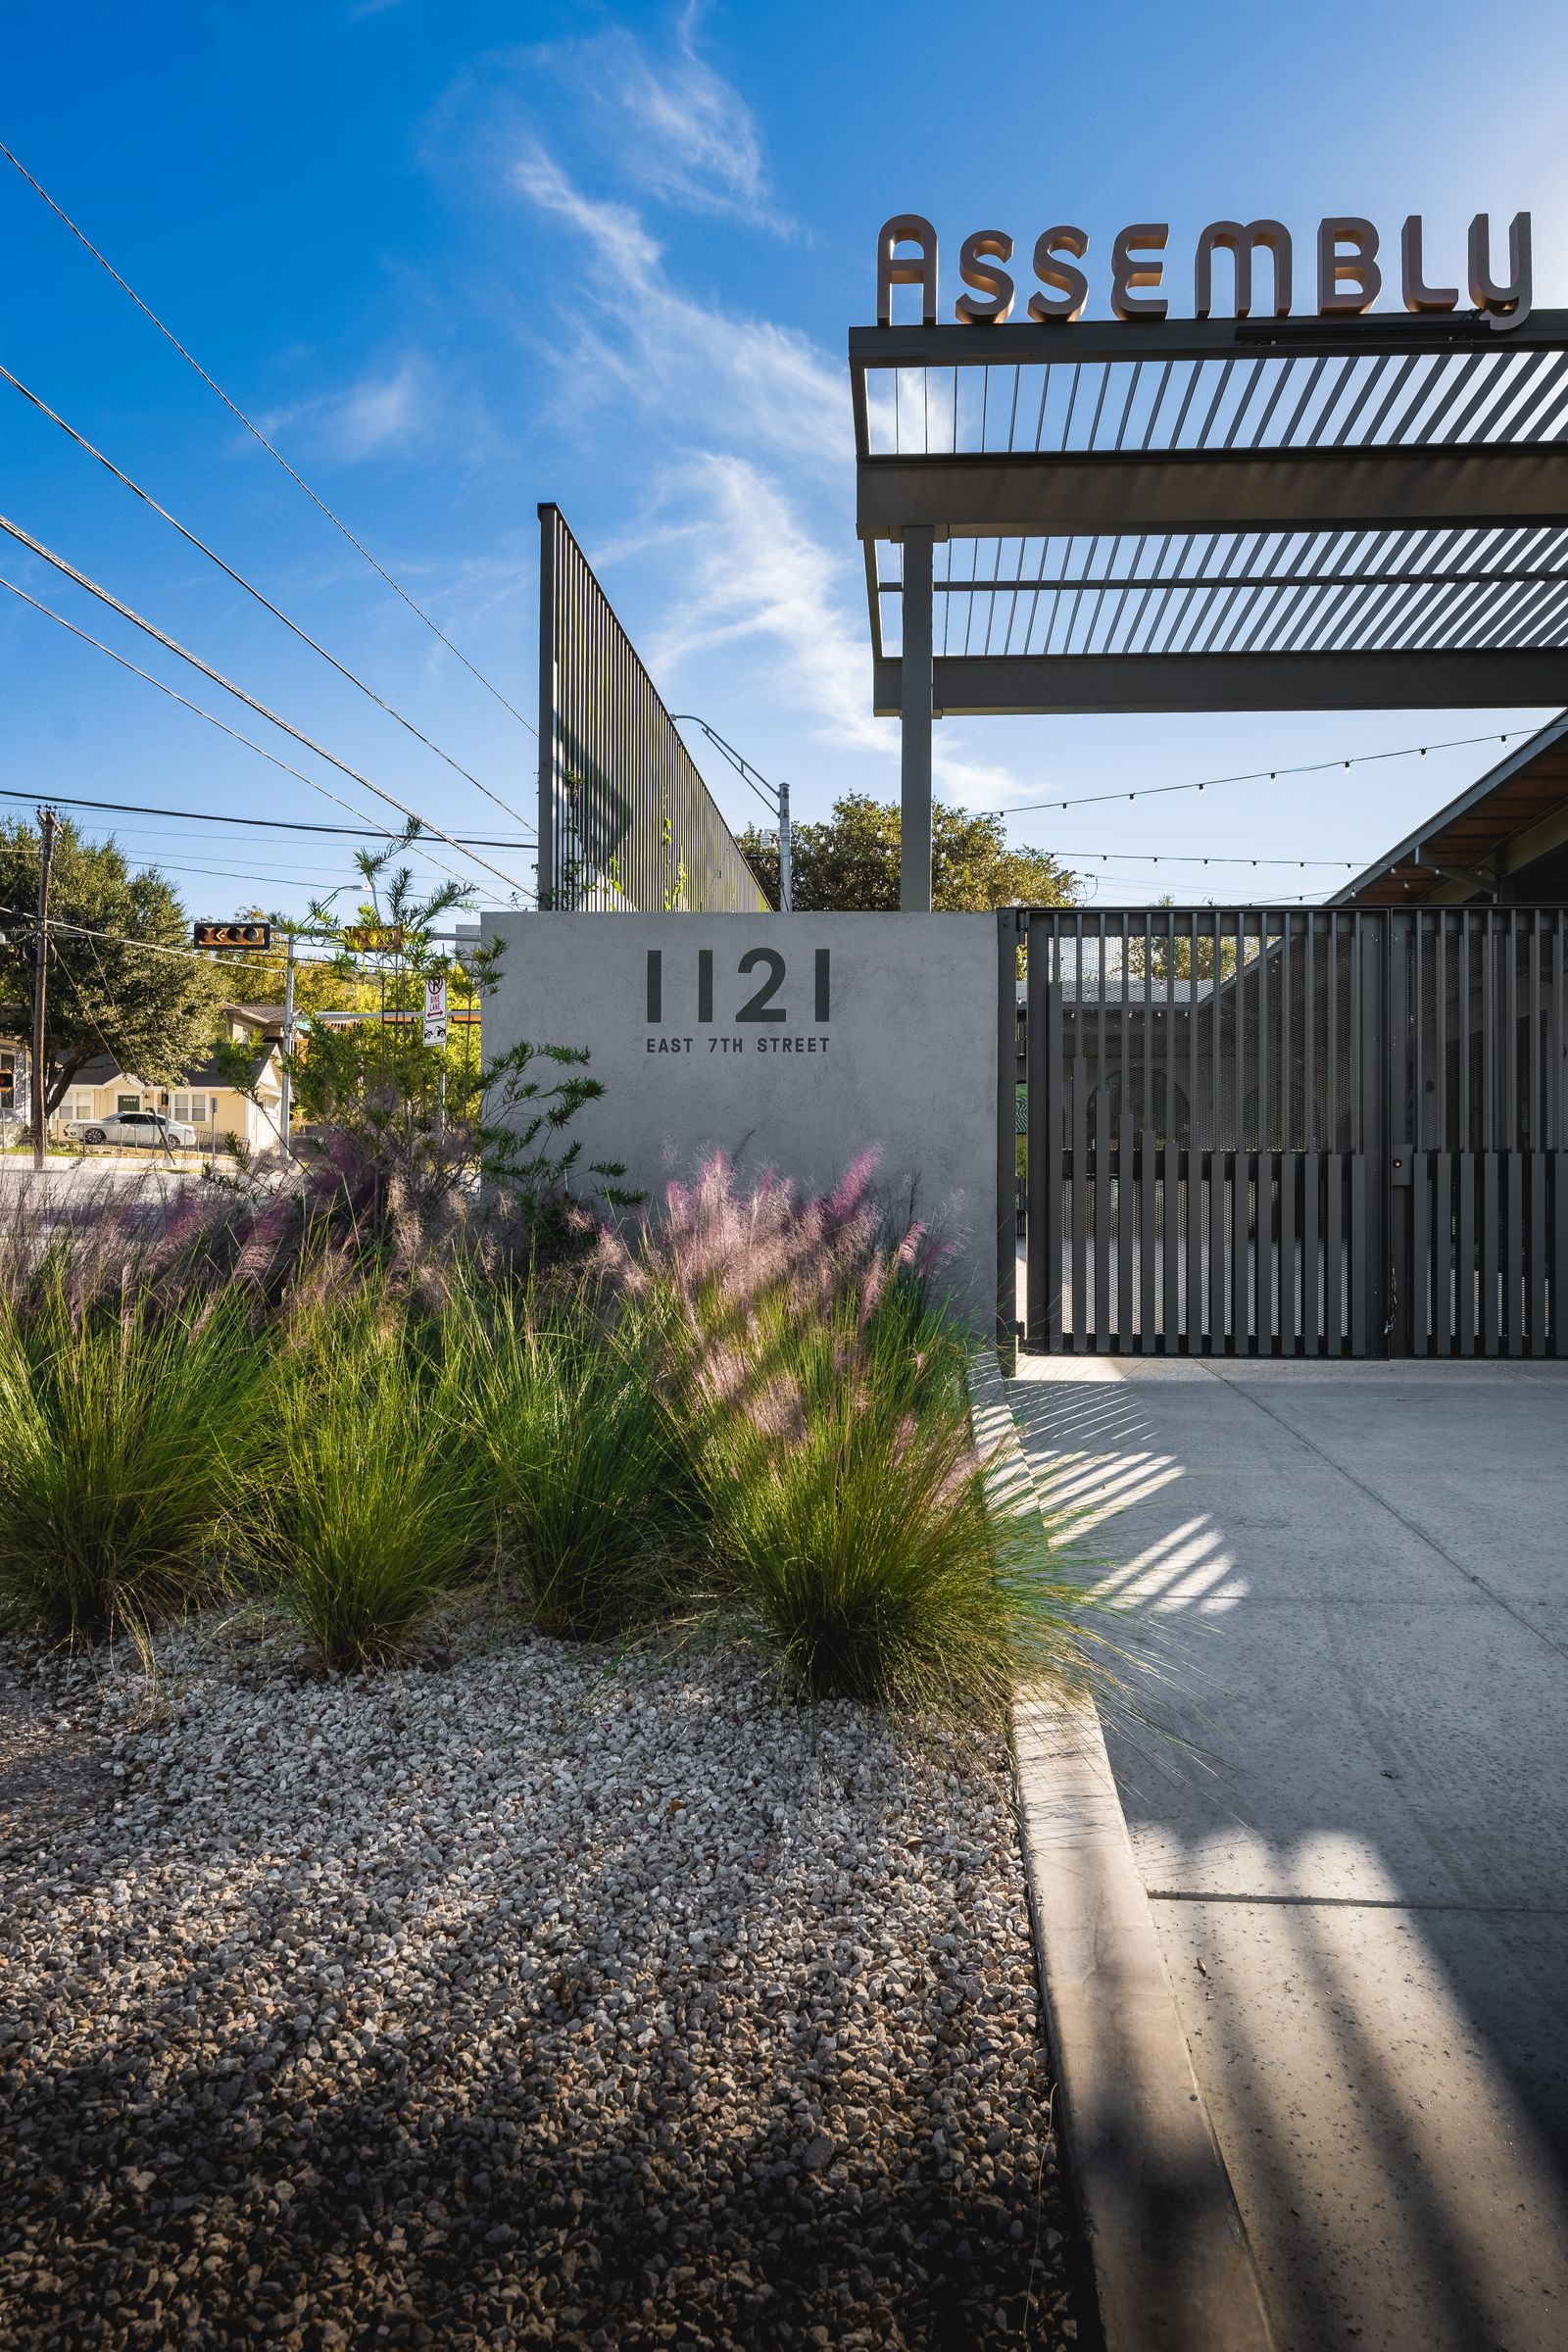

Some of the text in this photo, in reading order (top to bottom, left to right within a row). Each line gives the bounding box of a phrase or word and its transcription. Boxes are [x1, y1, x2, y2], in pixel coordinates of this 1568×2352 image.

[877, 212, 1533, 330] ASSEMBLY
[647, 947, 830, 1023] 1121
[430, 995, 440, 1004] BIKE
[430, 1003, 441, 1011] LANE
[646, 1037, 830, 1054] EAST 7TH STREET
